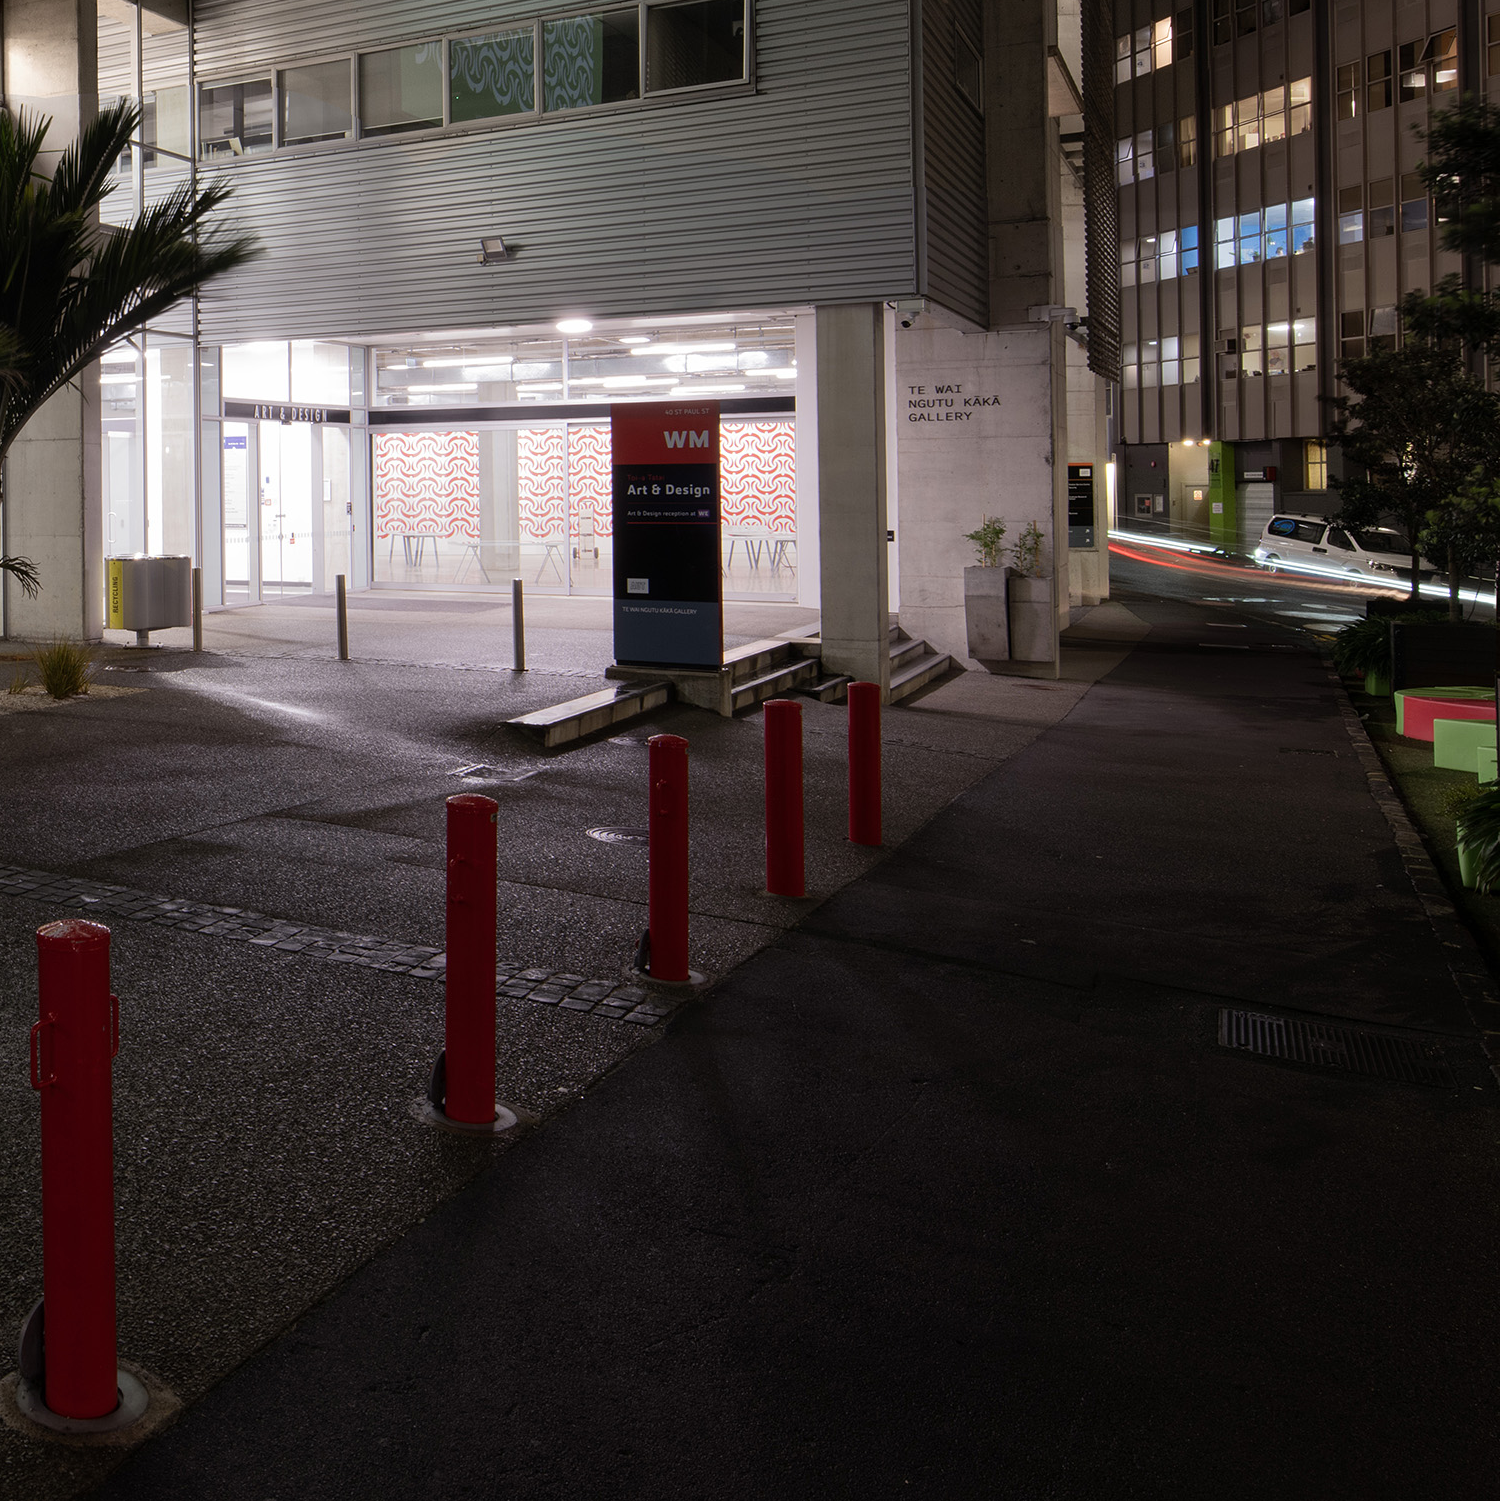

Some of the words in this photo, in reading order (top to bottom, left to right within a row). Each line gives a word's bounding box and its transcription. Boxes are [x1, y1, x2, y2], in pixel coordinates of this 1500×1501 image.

[908, 385, 926, 395] TE
[935, 384, 962, 394] WAI
[908, 398, 954, 409] NGUTU
[963, 395, 1001, 407] KĀKĀ
[254, 404, 273, 419] ART
[279, 406, 286, 420] &
[291, 407, 328, 422] DESIGN
[908, 412, 973, 422] GALLERY
[663, 430, 709, 448] WM
[627, 484, 648, 495] Art
[651, 484, 661, 495] &
[665, 484, 710, 498] Design
[642, 510, 662, 518] Design
